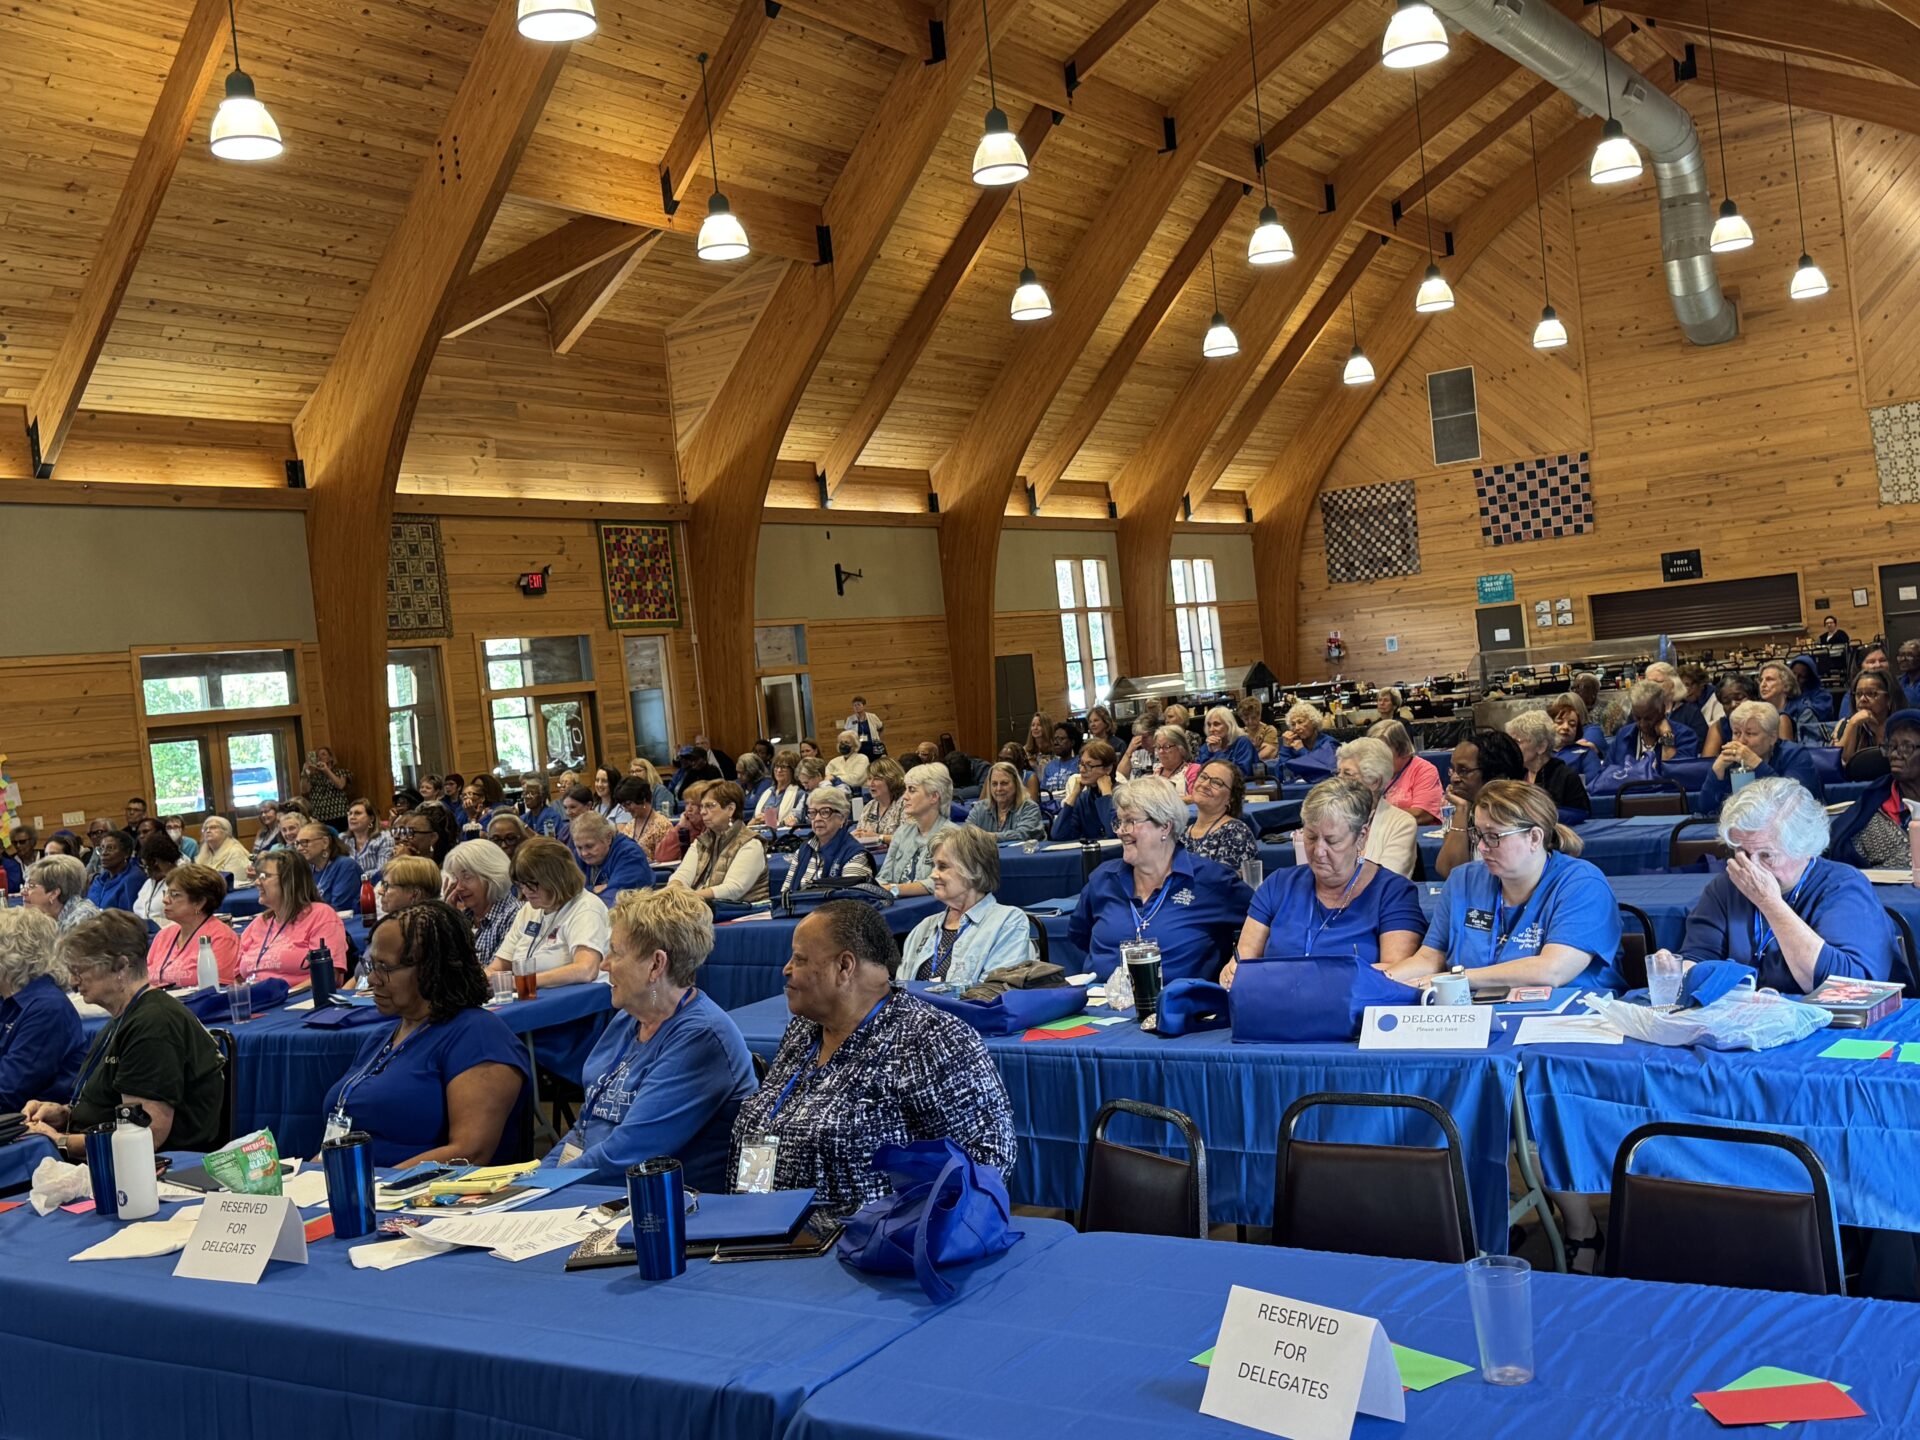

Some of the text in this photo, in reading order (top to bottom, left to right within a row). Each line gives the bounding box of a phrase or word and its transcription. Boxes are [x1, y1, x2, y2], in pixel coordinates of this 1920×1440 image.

[1669, 565, 1693, 573] REFILLS
[528, 574, 543, 589] EXIT
[1402, 1014, 1476, 1023] DELEGATES
[247, 1149, 267, 1162] HONEY
[220, 1200, 268, 1214] RESERVED
[226, 1222, 247, 1234] FOR
[201, 1240, 257, 1255] DELEGATES
[1257, 1303, 1339, 1335] RESERVED
[1273, 1340, 1307, 1362] FOR
[1238, 1362, 1329, 1400] DELEGATES
